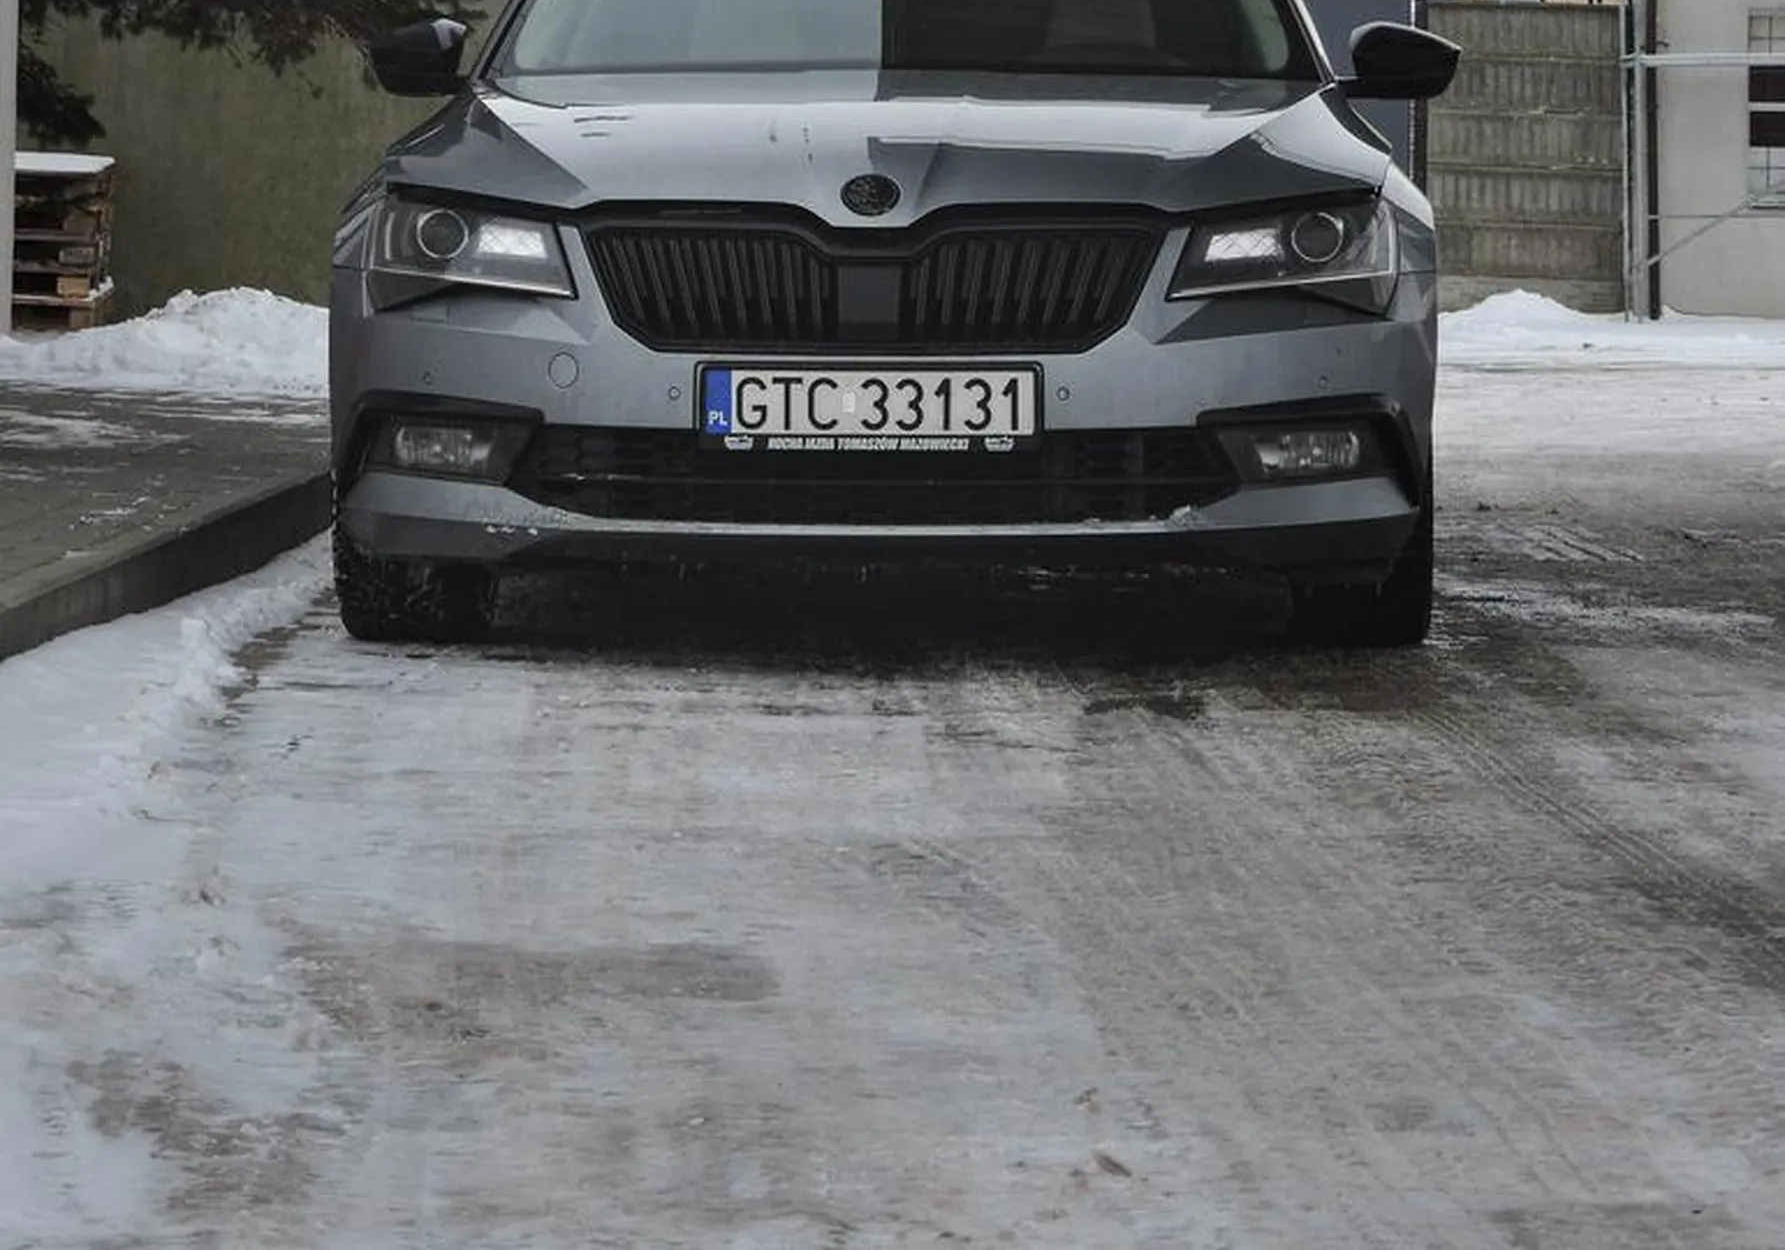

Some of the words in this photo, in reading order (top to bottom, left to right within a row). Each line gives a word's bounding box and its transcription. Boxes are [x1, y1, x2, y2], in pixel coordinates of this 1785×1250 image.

[707, 410, 728, 426] PL
[735, 376, 839, 431] GTC
[860, 376, 1019, 431] 33131
